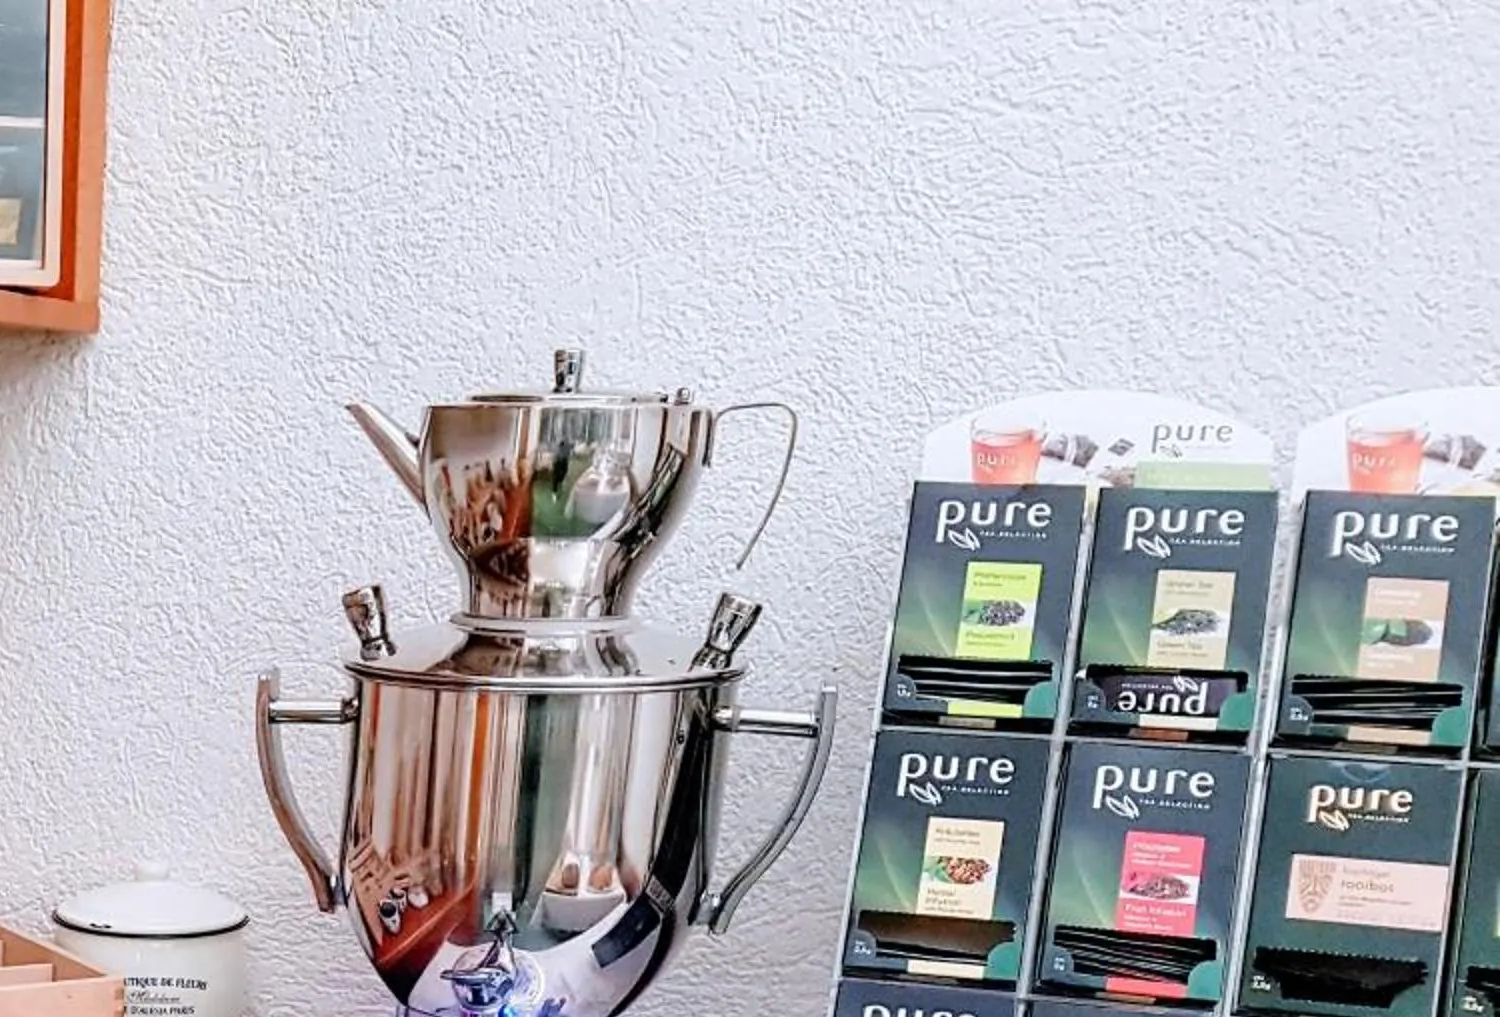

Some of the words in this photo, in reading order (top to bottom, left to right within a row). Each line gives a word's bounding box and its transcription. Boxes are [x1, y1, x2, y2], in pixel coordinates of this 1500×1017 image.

[1151, 425, 1233, 454] pure
[936, 501, 1051, 543] pure
[1123, 507, 1245, 550] pure
[1331, 511, 1459, 557] pure
[1117, 681, 1208, 715] pure
[896, 753, 1015, 797] pure
[1092, 765, 1215, 809] pure
[1307, 784, 1413, 823] pure
